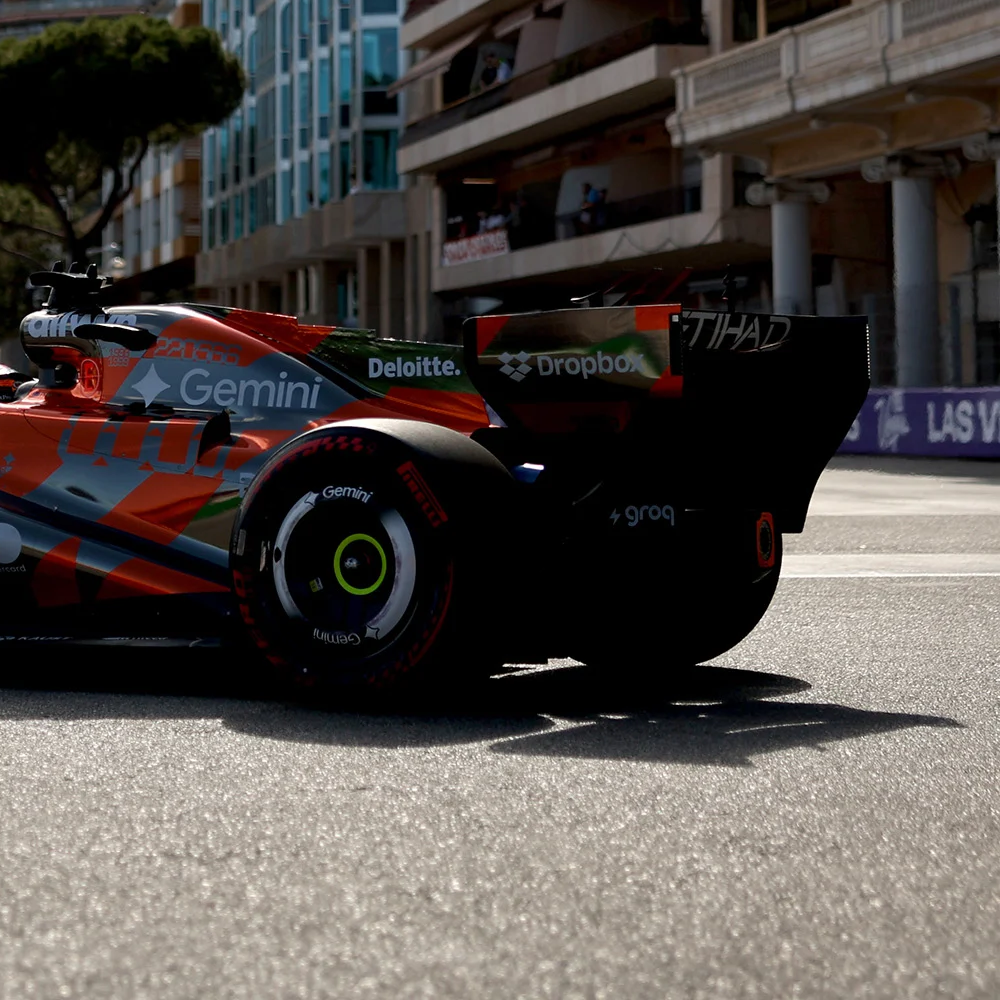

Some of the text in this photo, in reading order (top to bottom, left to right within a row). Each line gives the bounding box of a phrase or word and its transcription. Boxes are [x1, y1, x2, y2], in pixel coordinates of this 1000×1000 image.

[368, 356, 461, 379] Deloitte.
[537, 350, 645, 379] Dropbox
[180, 369, 323, 409] Gemini
[927, 400, 975, 443] LAS
[323, 485, 374, 504] Gemini
[625, 504, 676, 526] groq
[313, 628, 362, 646] Gemini
